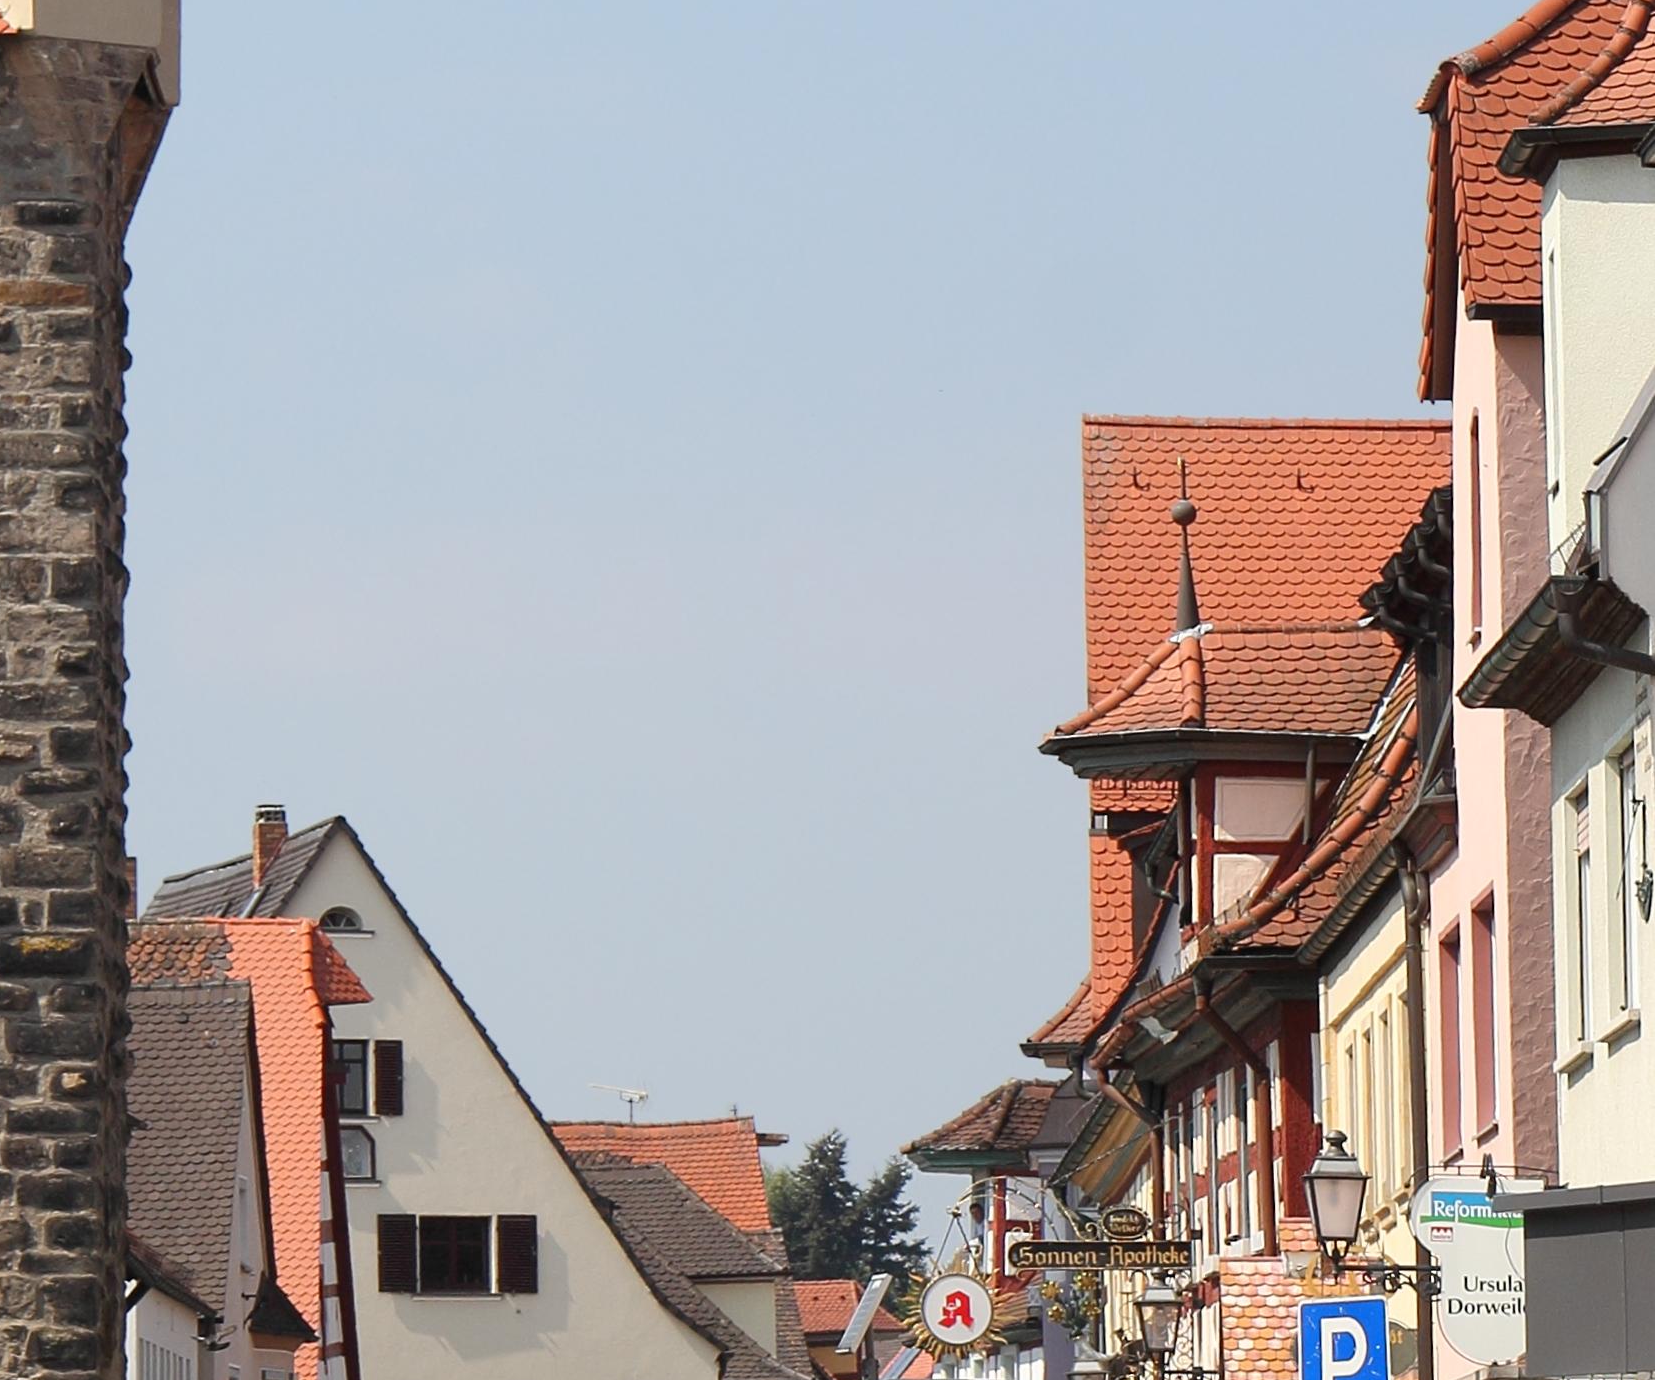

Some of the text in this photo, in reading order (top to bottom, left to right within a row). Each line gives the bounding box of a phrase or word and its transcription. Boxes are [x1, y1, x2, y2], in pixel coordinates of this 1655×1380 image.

[1433, 1199, 1524, 1223] Reform
[1016, 1244, 1189, 1268] Sonnen-Apotheke
[1463, 1274, 1524, 1293] Ursula
[938, 1290, 975, 1328] A
[1447, 1298, 1526, 1316] Dorweil
